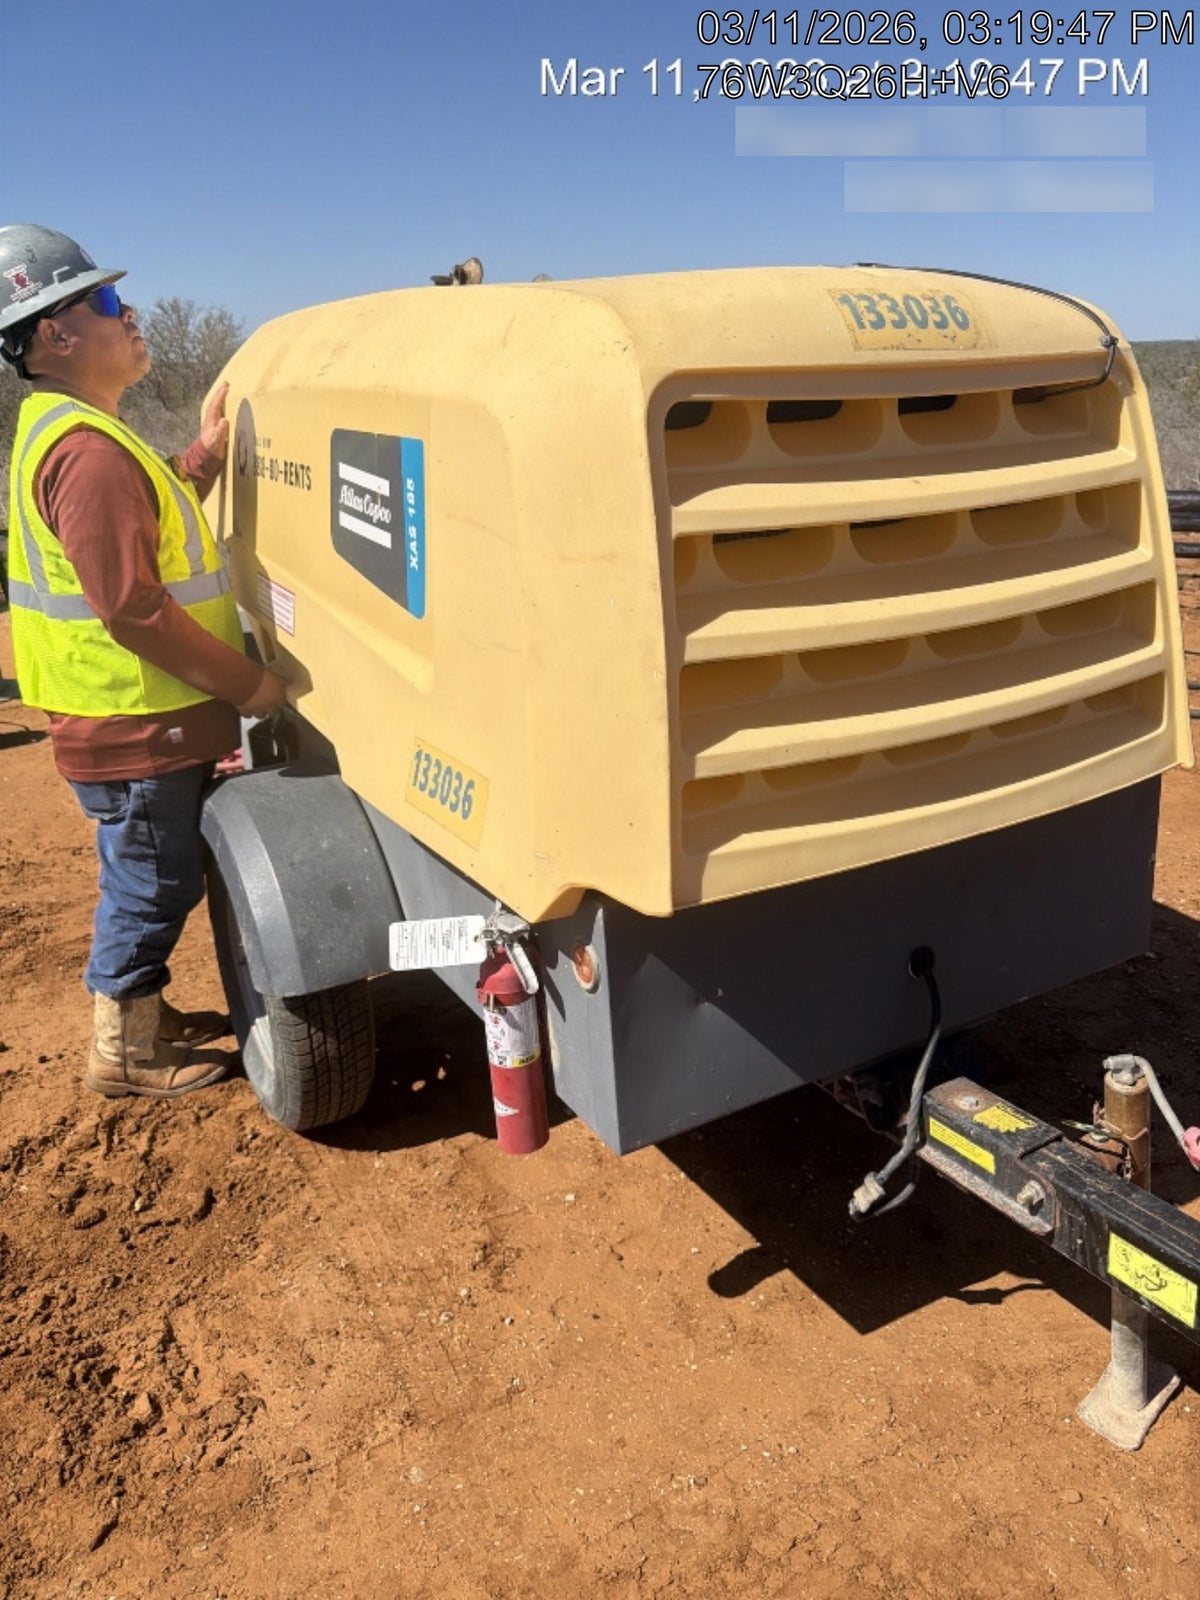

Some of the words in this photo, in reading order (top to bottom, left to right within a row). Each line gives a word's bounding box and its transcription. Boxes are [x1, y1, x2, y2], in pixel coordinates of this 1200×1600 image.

[838, 293, 970, 331] 133036
[340, 485, 364, 513] Atlas
[364, 494, 392, 524] Copco
[408, 525, 419, 571] XAS
[412, 749, 476, 820] 133036
